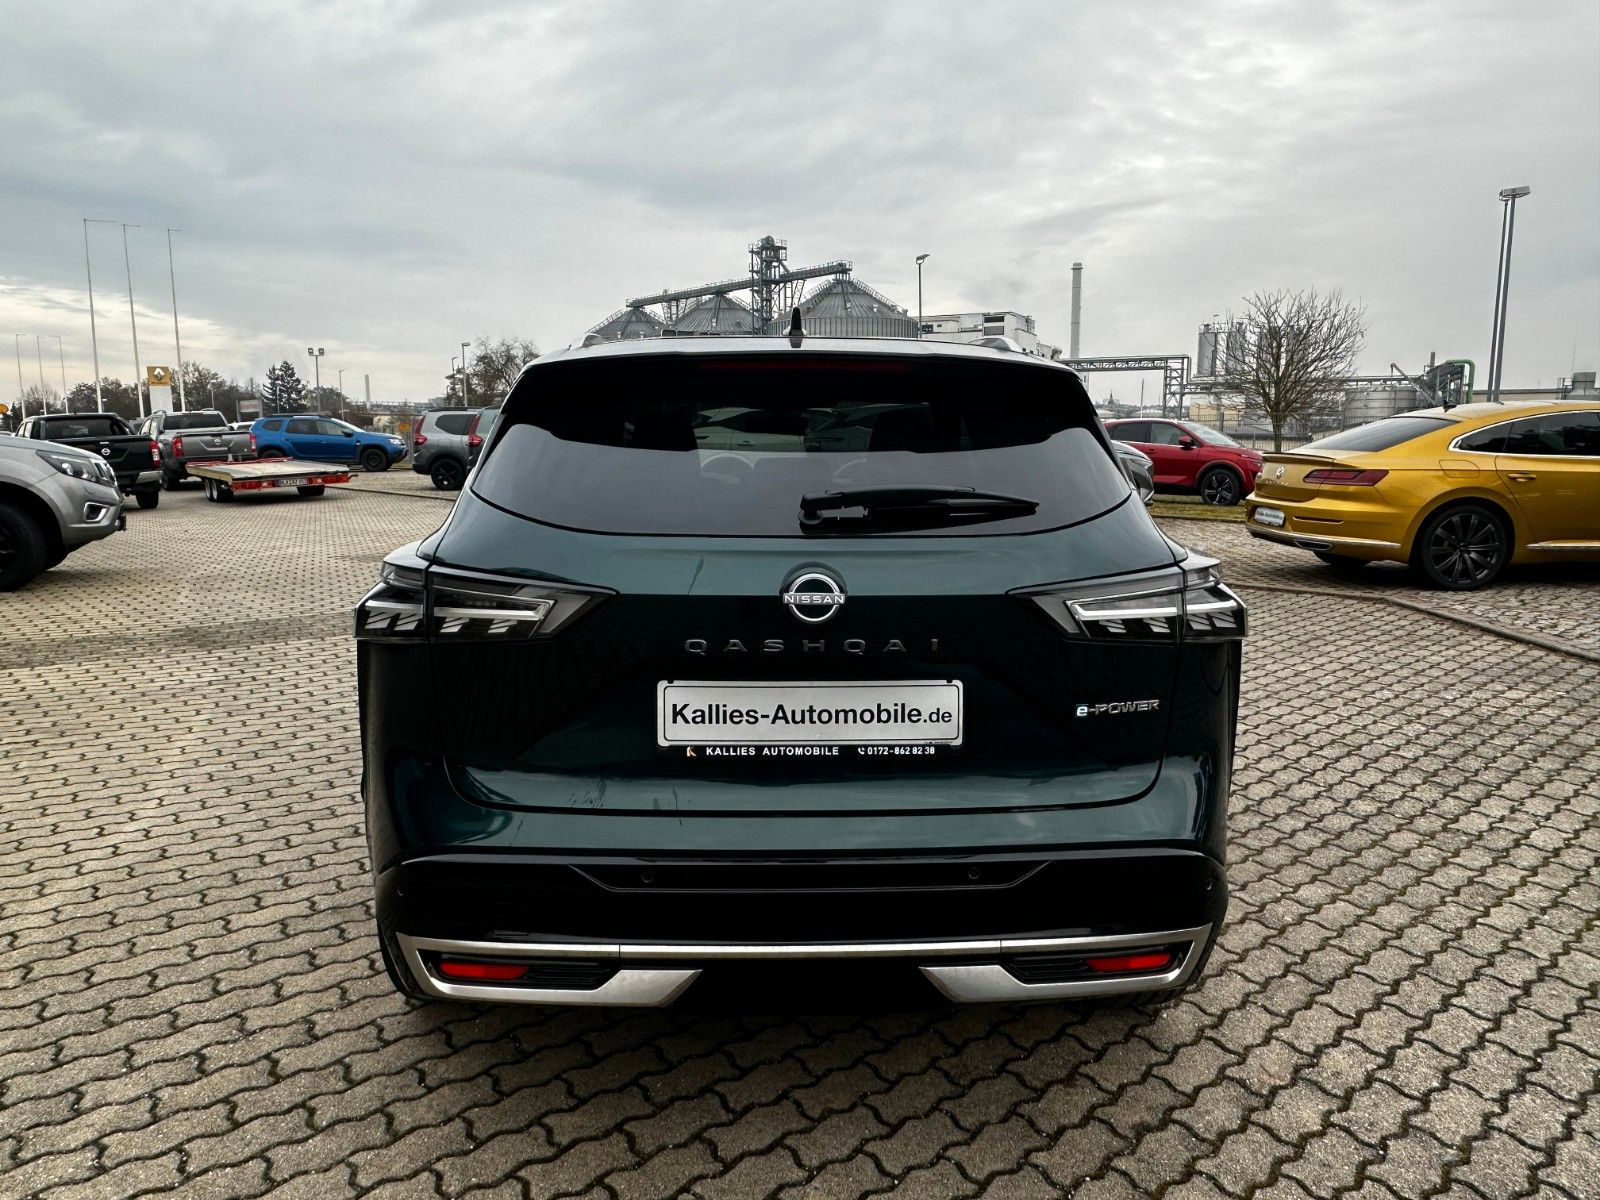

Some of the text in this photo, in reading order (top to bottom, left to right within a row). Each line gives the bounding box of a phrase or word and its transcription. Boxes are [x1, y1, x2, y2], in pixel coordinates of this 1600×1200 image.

[784, 595, 845, 604] NISSAN
[684, 639, 939, 656] QASHQAI
[671, 702, 953, 725] Kallies-Automobile.de
[1075, 699, 1160, 717] e-POWER
[706, 746, 756, 756] KALLIES
[762, 746, 840, 756] AUTOMOBILE
